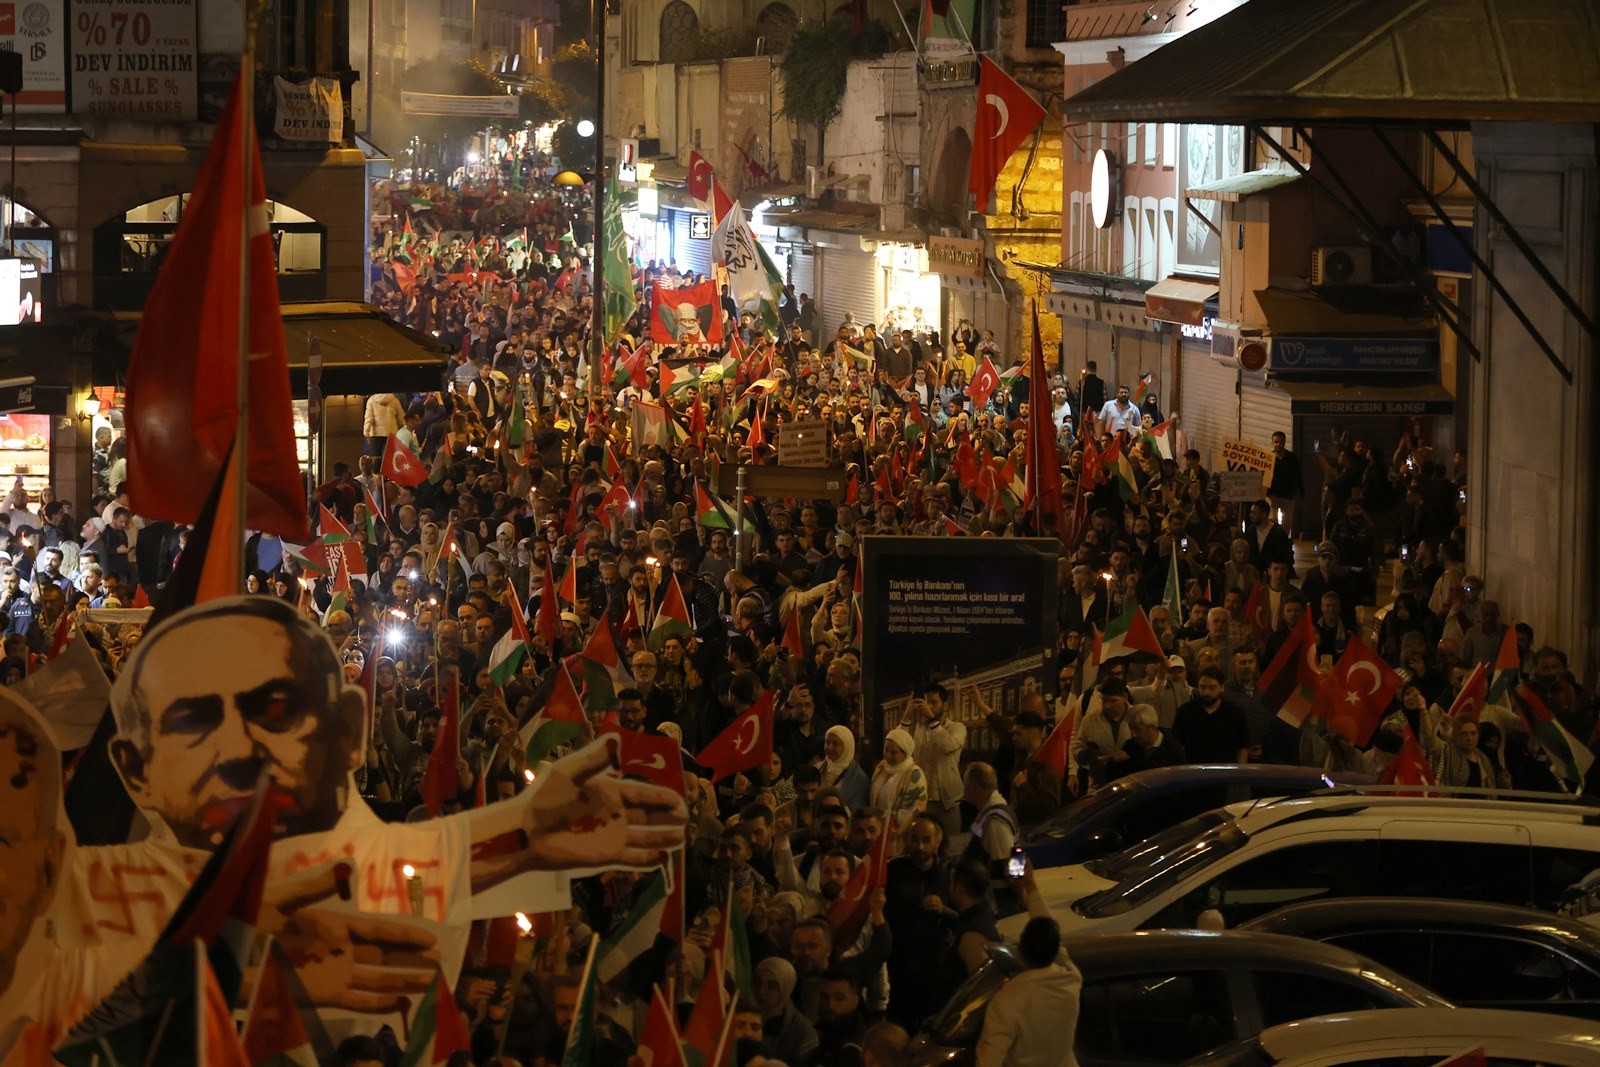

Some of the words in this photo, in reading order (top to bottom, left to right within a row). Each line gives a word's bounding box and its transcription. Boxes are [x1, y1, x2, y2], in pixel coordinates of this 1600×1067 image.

[78, 12, 151, 46] %70
[75, 54, 112, 72] DEV
[117, 48, 192, 72] İNDİRİM
[110, 77, 158, 95] SALE
[88, 101, 182, 113] SUNGLASSES
[283, 118, 309, 128] DEV
[1224, 442, 1272, 462] GAZZE'DE
[1222, 450, 1272, 470] SOYKIRIM
[1227, 460, 1260, 472] VA
[889, 580, 915, 591] Türkiye
[889, 591, 903, 601] 100.
[925, 592, 968, 601] hazırlanmak
[969, 592, 983, 602] için
[1000, 592, 1010, 601] bir
